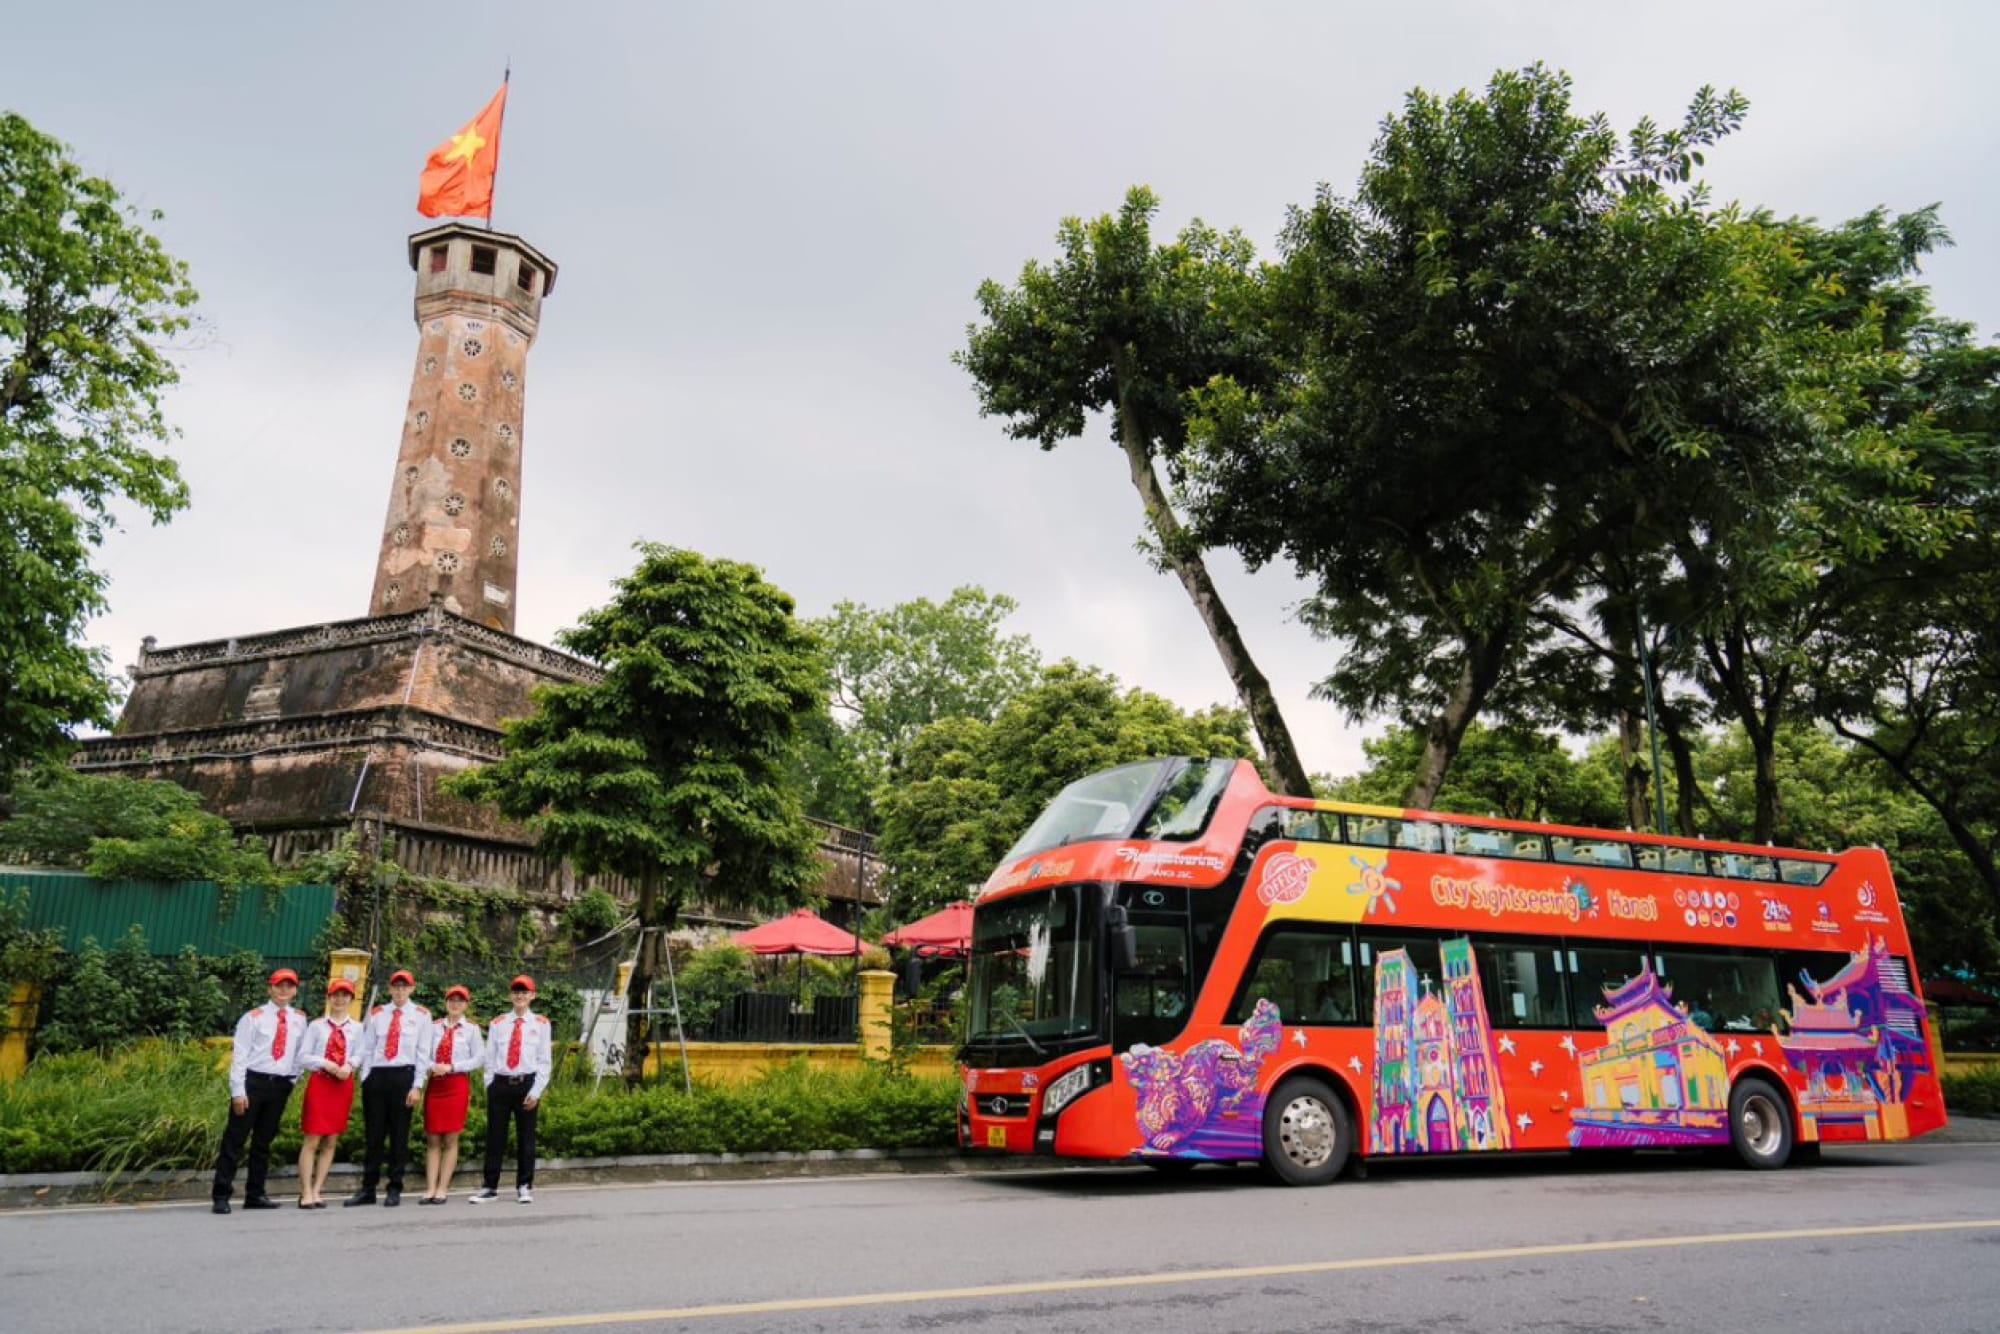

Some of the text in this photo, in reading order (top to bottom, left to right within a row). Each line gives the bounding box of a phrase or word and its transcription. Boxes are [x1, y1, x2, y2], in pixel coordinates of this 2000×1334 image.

[1263, 859, 1313, 898] OFFICIAL
[1431, 875, 1659, 922] City Sightseeing Hanoi
